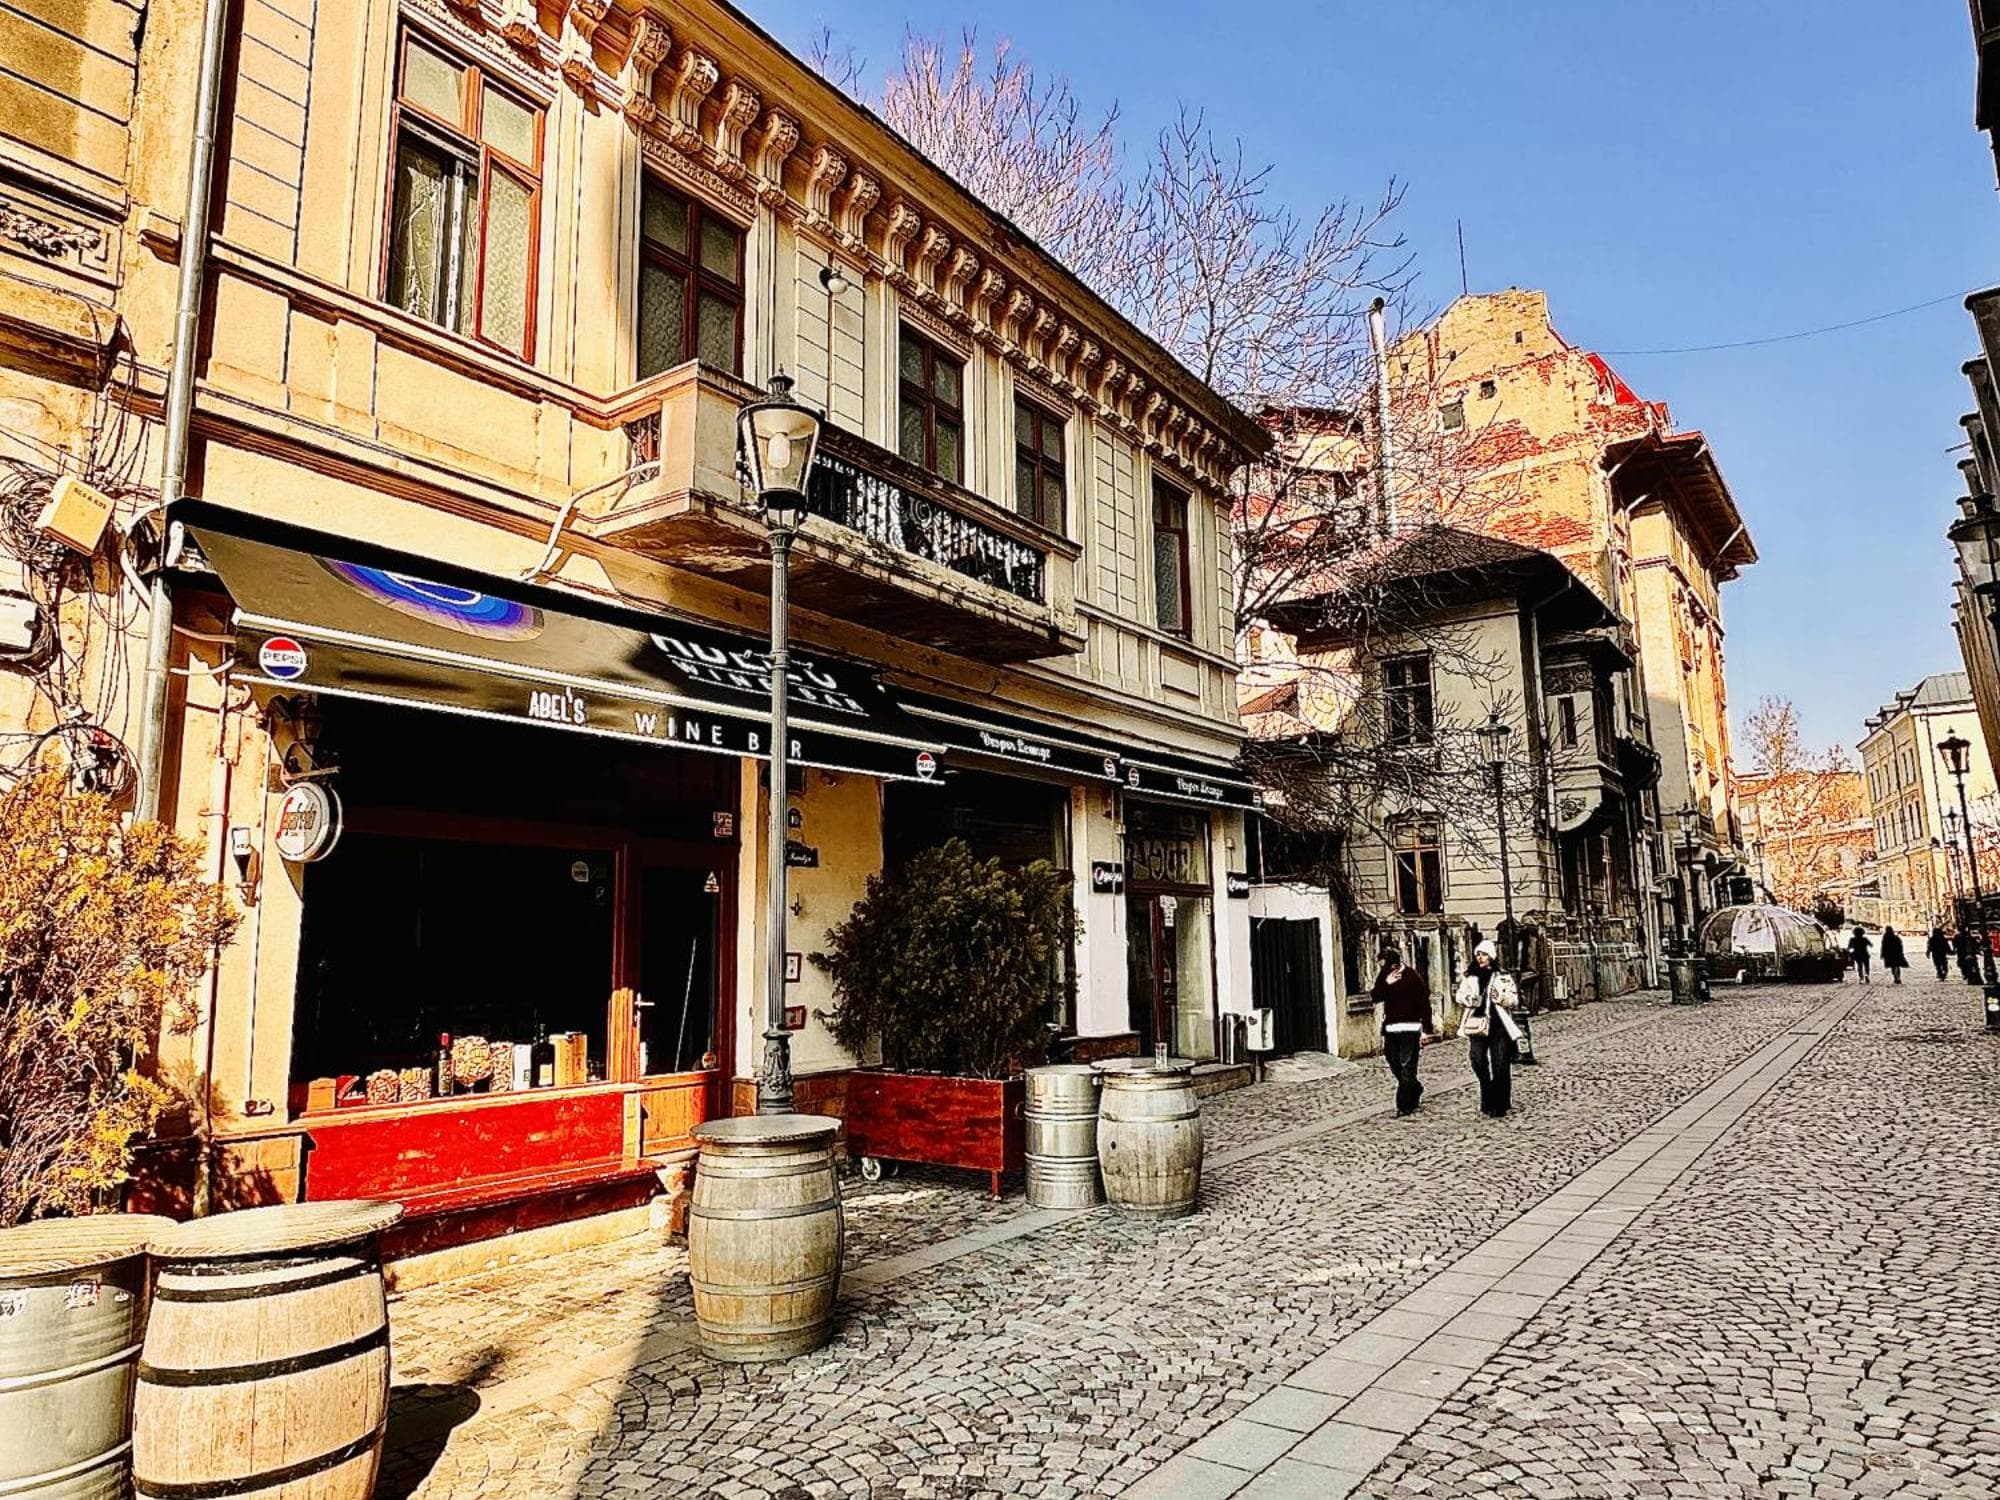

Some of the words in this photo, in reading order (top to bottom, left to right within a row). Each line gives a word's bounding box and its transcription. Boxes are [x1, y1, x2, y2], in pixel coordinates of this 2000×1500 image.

[263, 651, 303, 664] PEPSI
[528, 686, 585, 724] ABEL'S
[634, 712, 723, 745] WINE
[748, 731, 802, 758] BR
